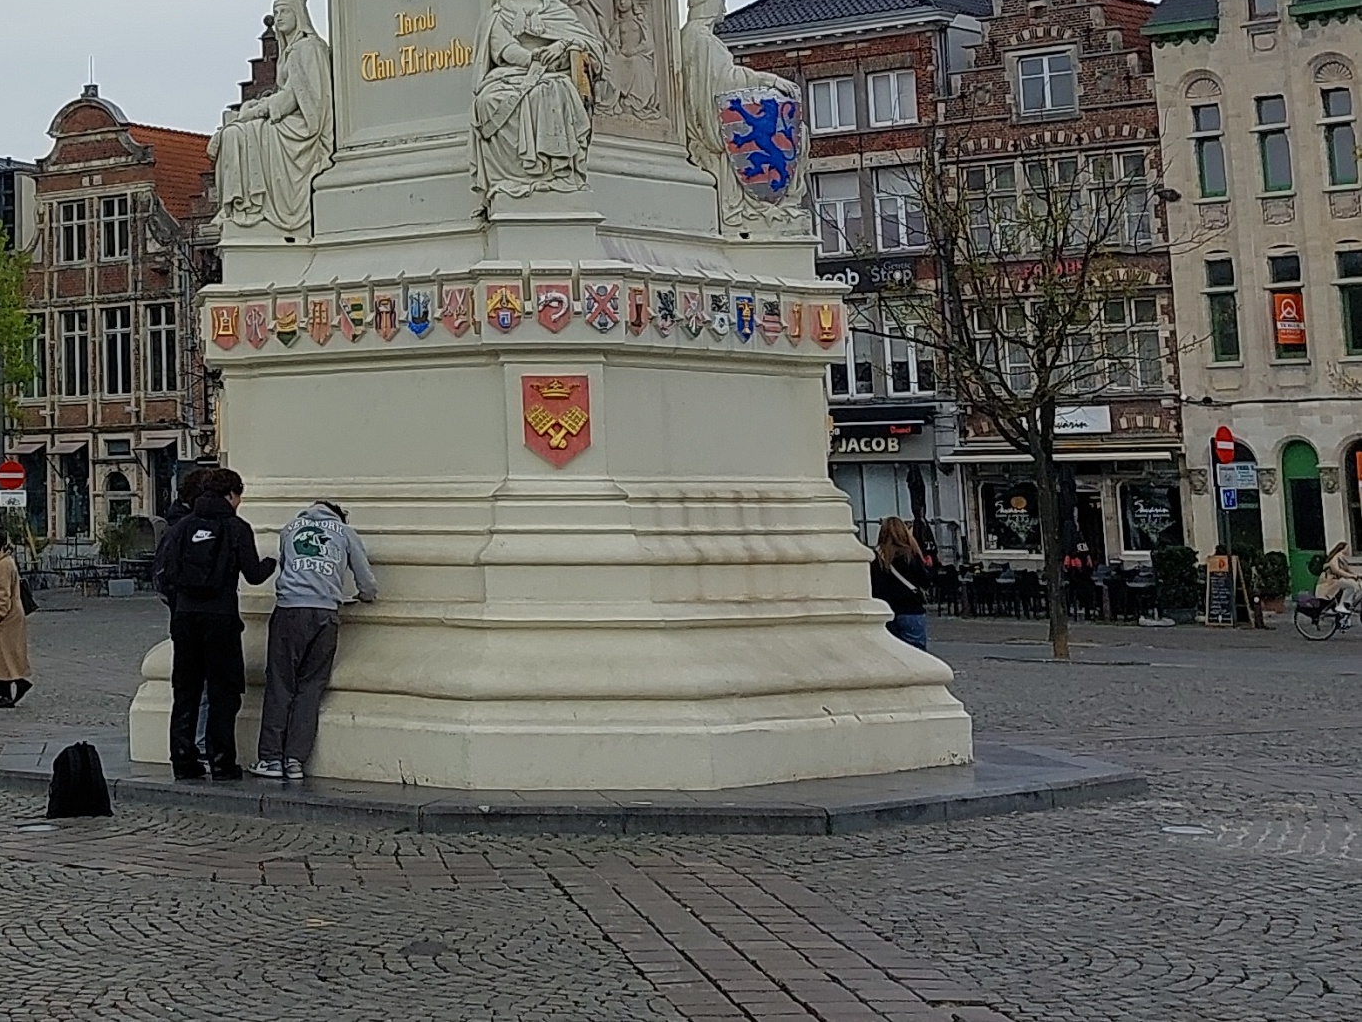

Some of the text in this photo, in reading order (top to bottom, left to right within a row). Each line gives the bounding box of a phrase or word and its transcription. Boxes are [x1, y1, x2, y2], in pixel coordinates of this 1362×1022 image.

[361, 39, 473, 82] Van Artevelde
[838, 437, 900, 453] JACOB
[287, 519, 344, 536] NEW YORK
[292, 558, 335, 576] JETS
